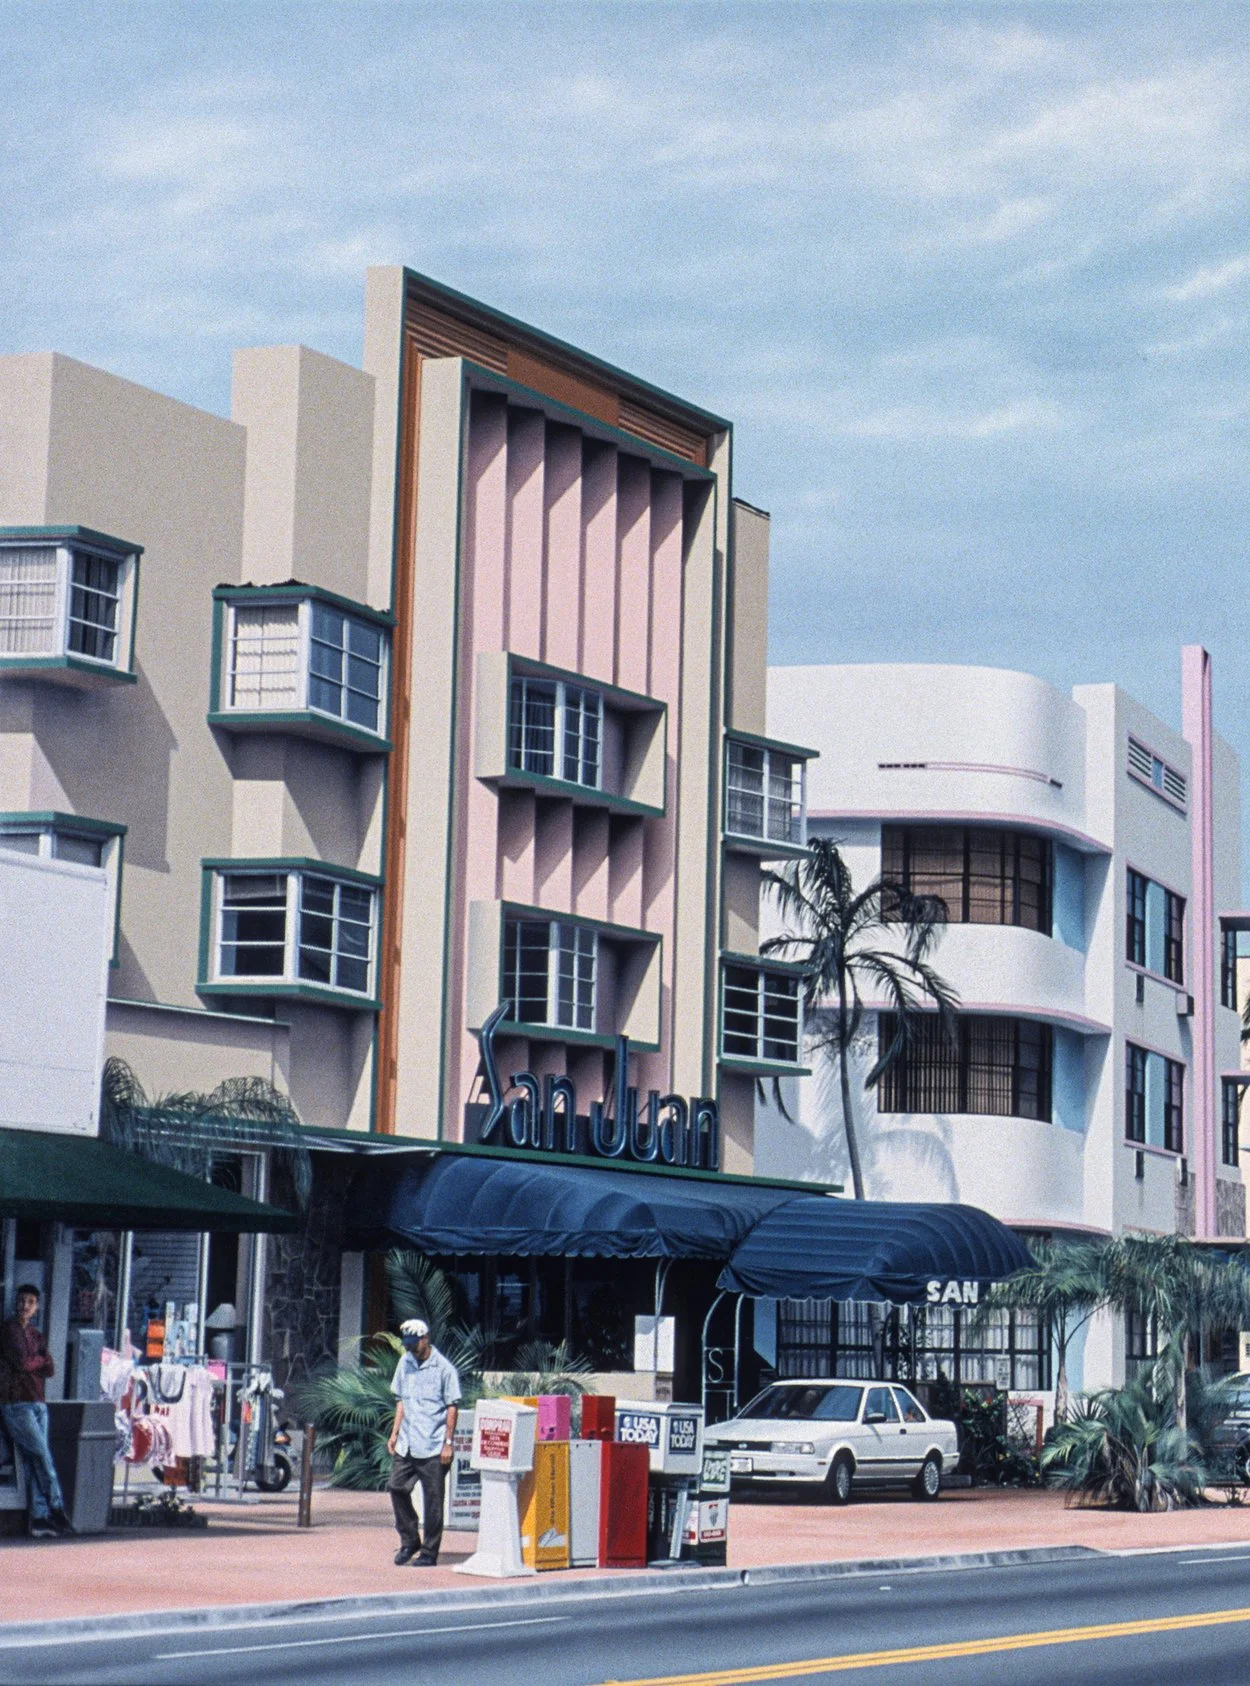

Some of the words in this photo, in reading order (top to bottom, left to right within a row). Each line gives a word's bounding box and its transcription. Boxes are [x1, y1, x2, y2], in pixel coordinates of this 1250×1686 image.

[479, 1002, 575, 1152] San
[590, 1035, 721, 1171] Juan
[926, 1280, 979, 1304] SAN
[633, 1415, 657, 1431] USA
[679, 1419, 695, 1435] USA
[620, 1427, 660, 1445] TODAY
[670, 1433, 696, 1450] TODAY
